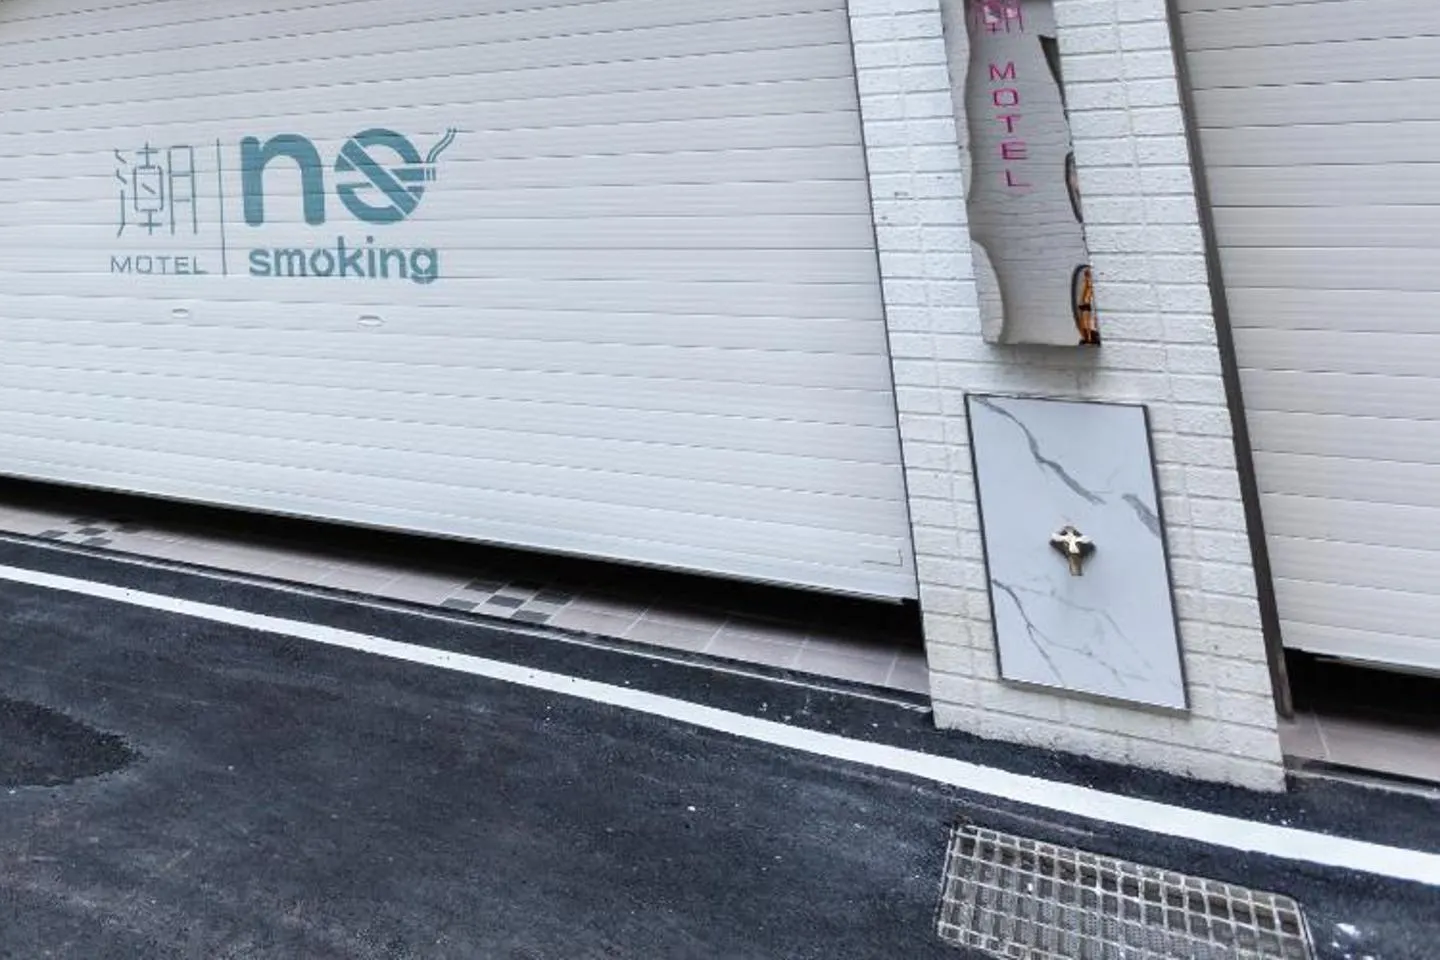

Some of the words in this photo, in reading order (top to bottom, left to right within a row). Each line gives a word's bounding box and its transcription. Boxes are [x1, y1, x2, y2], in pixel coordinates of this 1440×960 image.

[988, 60, 1032, 188] MOTEL
[110, 256, 208, 275] MOTEL
[249, 237, 439, 284] smoking
